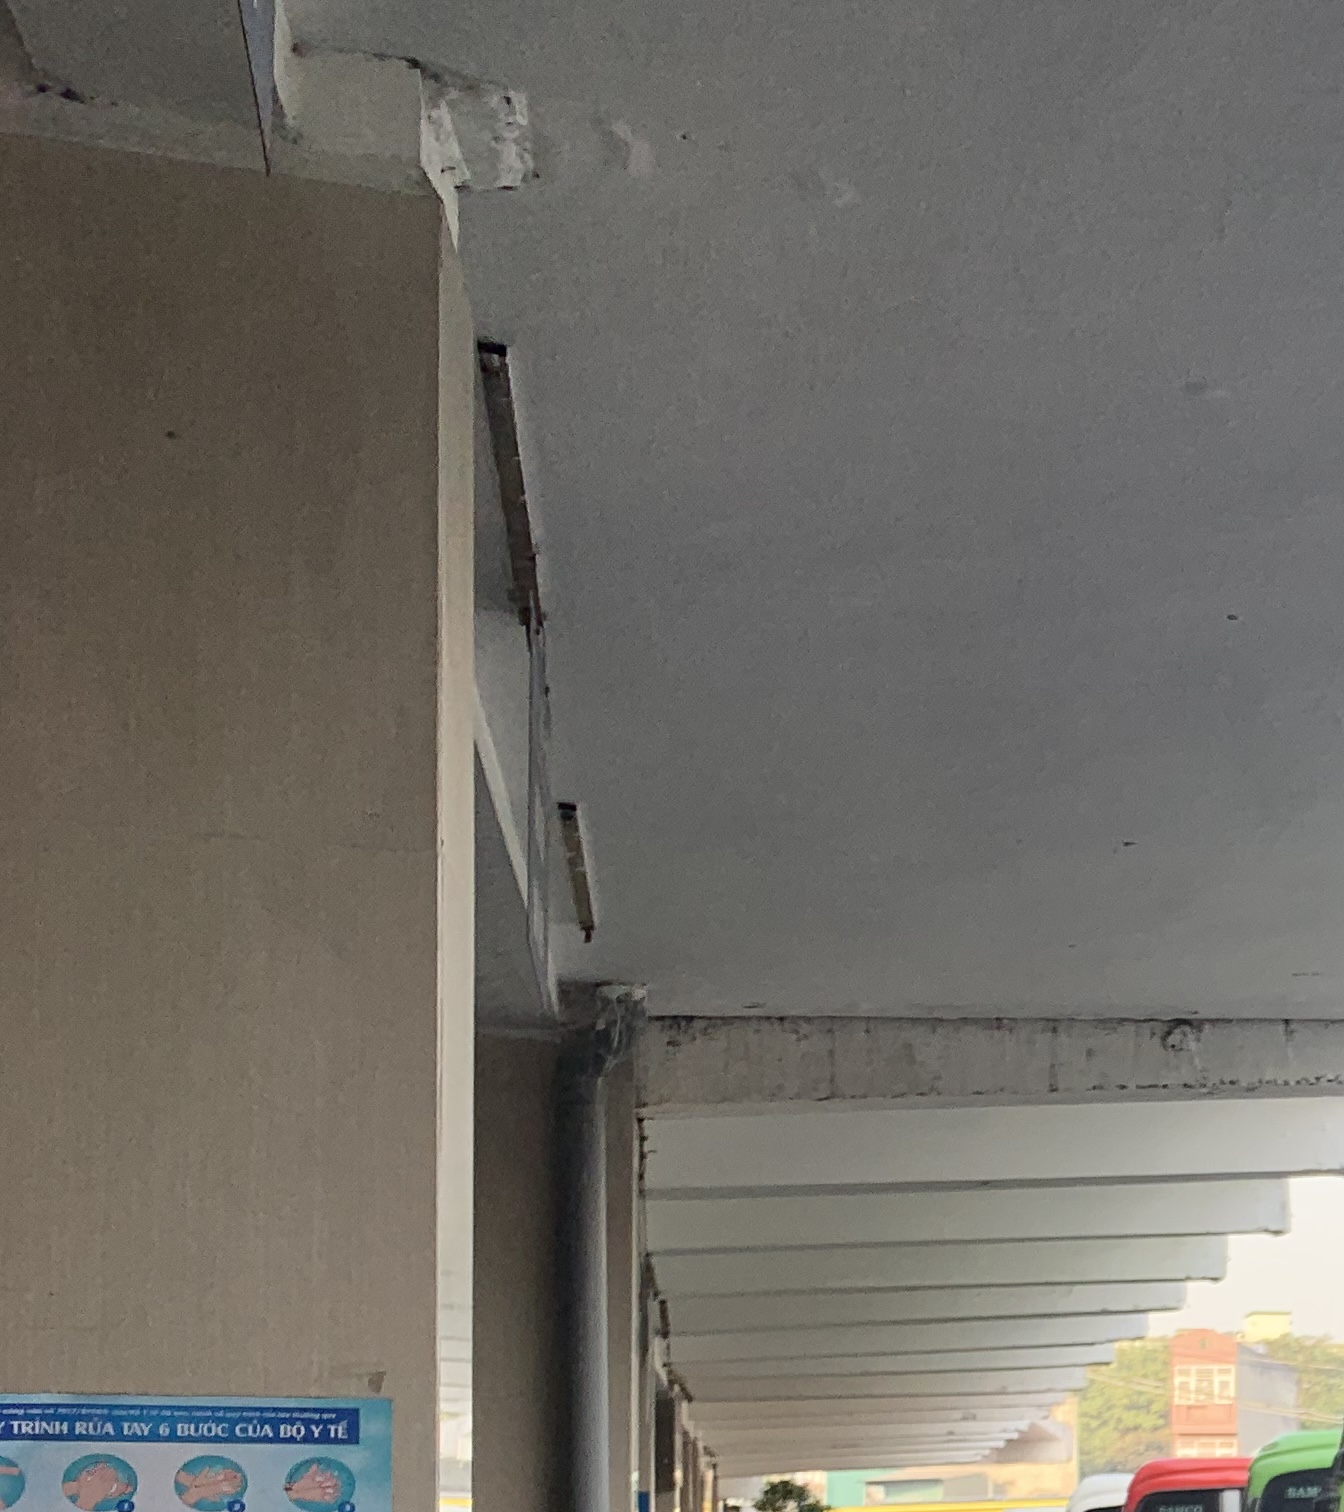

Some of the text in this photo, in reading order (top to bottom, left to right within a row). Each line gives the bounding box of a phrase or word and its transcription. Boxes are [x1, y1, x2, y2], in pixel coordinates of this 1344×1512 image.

[123, 1421, 153, 1436] TAY
[159, 1422, 170, 1437] 6
[310, 1424, 324, 1439] Y
